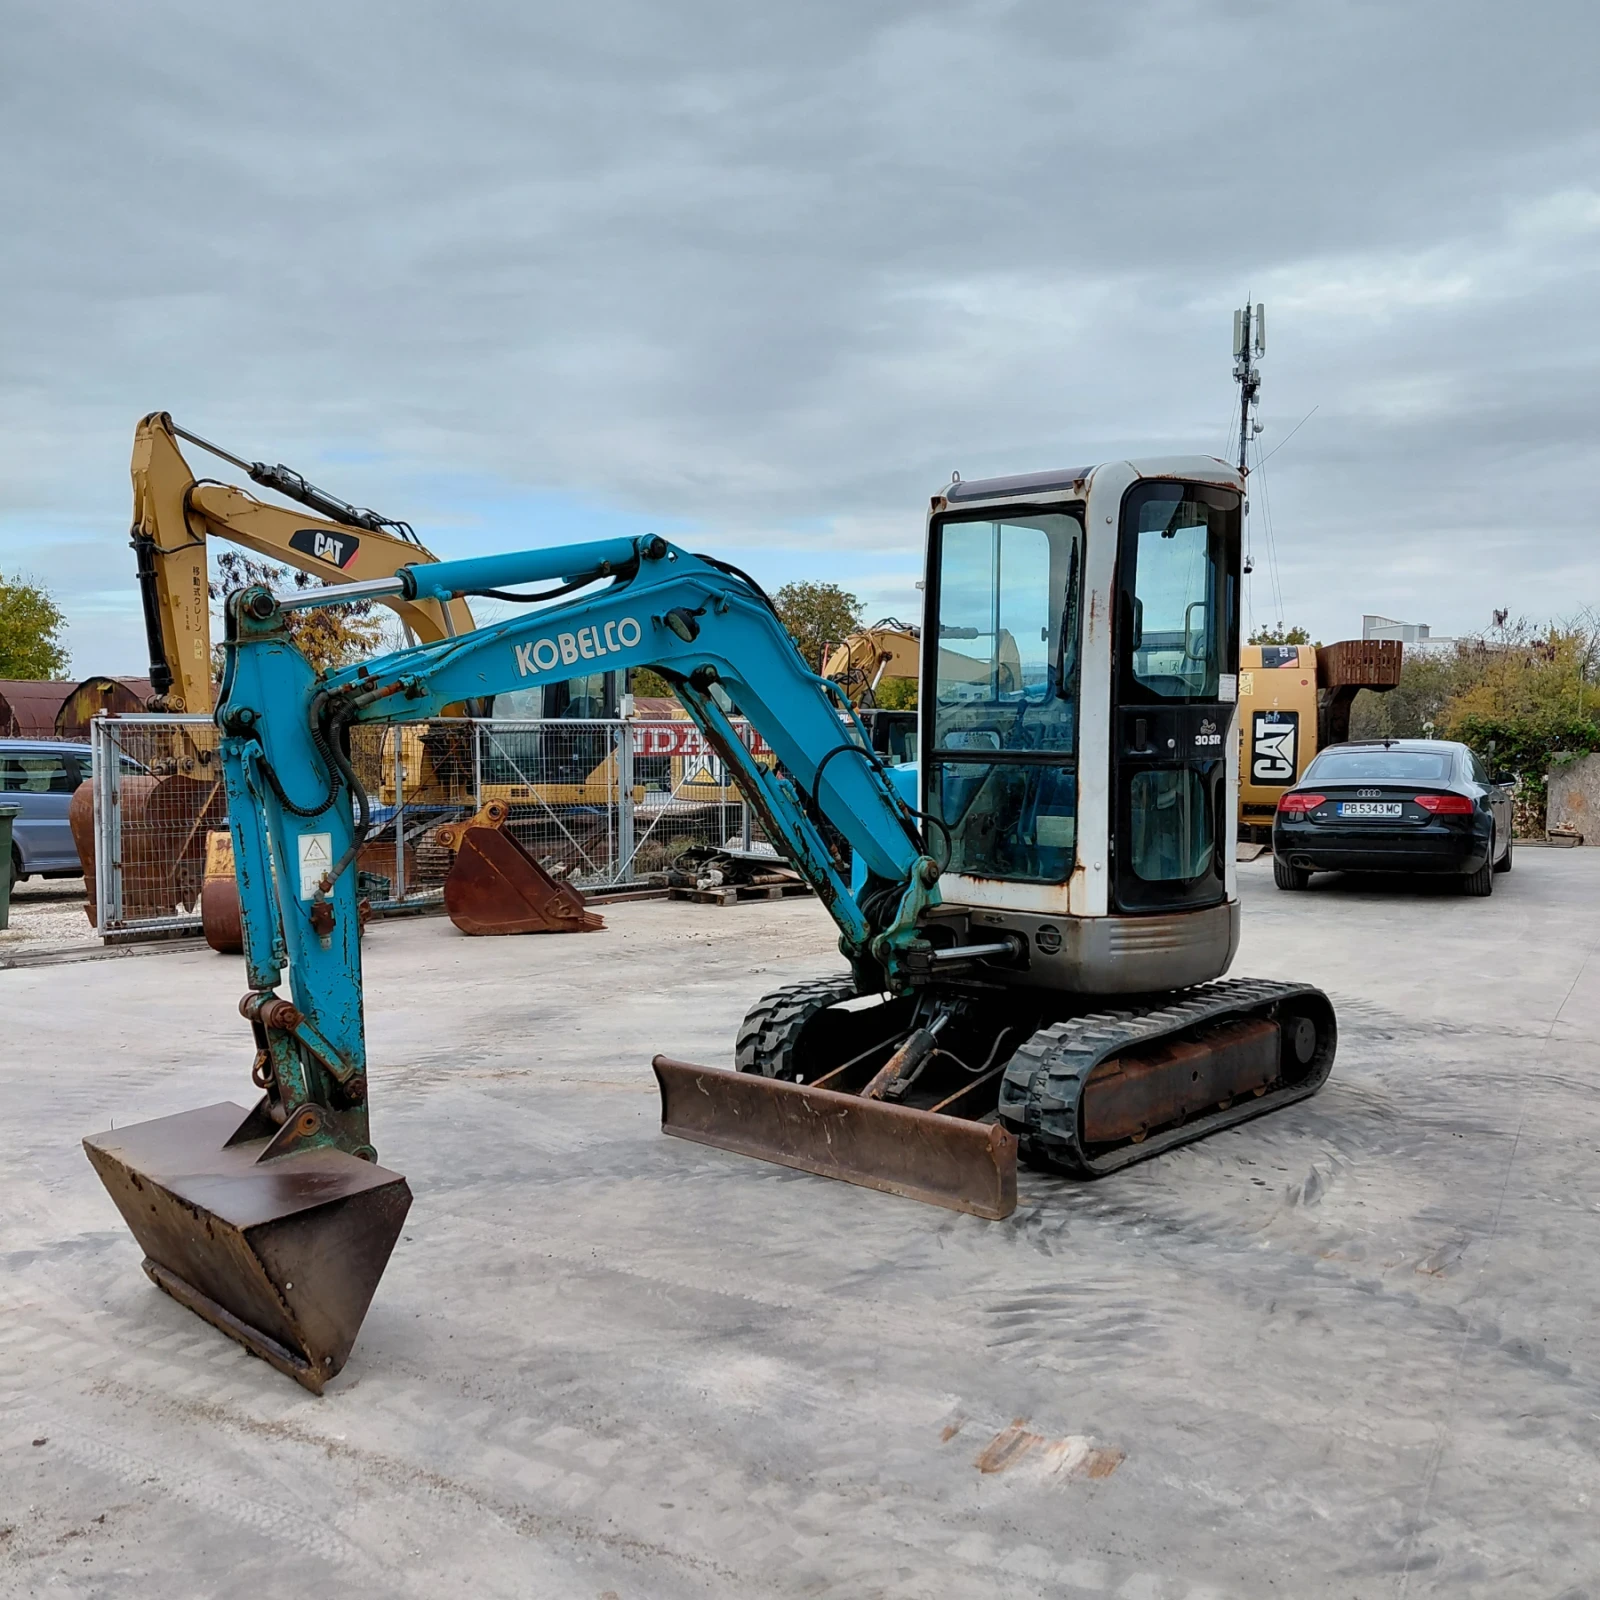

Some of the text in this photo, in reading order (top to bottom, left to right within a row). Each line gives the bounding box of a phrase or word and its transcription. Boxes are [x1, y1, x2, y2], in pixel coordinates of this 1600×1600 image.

[314, 532, 343, 565] CAT
[514, 617, 642, 677] KOBELCO
[1195, 734, 1221, 745] 30SR
[1253, 718, 1295, 779] CAT
[1344, 804, 1400, 814] PB 5343 MC
